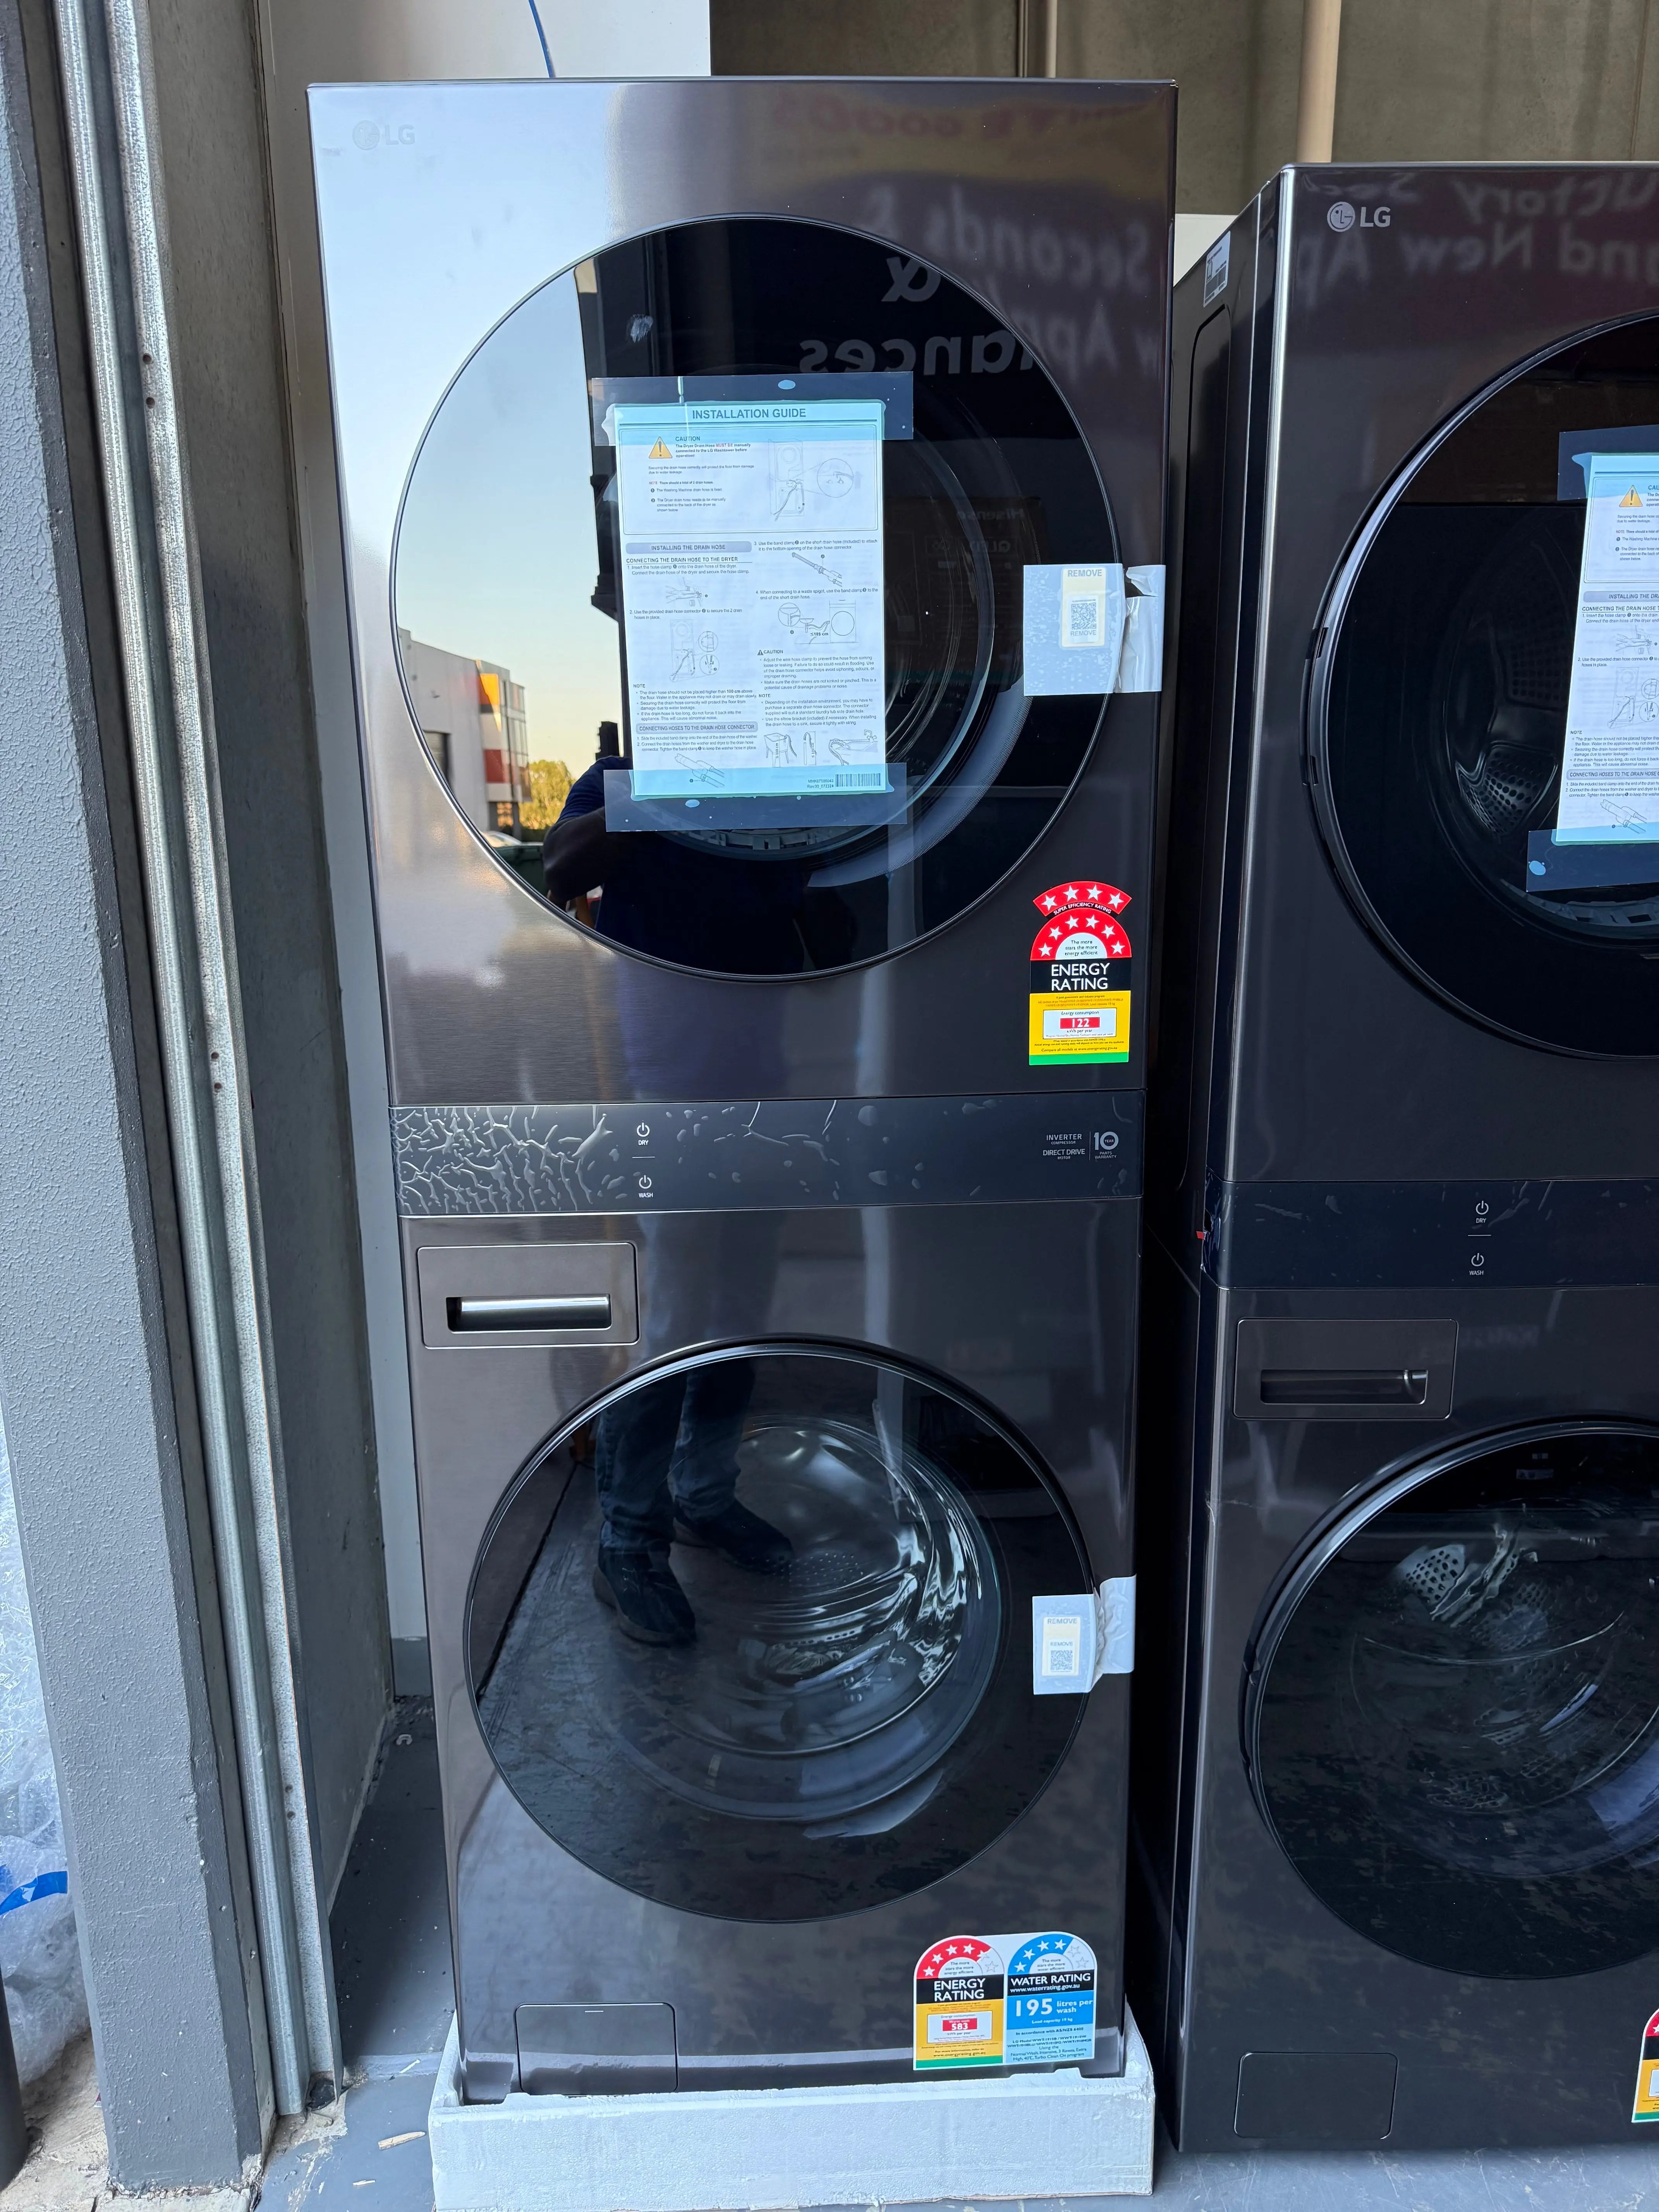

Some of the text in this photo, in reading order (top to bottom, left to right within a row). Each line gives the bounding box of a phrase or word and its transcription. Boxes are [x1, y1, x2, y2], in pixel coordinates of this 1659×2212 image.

[385, 124, 416, 145] LG
[1360, 206, 1391, 227] LG
[692, 408, 806, 419] INSTALLATION GUIDE
[1053, 906, 1067, 915] SUPER
[1094, 903, 1112, 914] RATING
[1051, 963, 1109, 976] ENERGY
[1051, 977, 1108, 991] RATING
[1072, 1018, 1089, 1028] 122
[1094, 1131, 1118, 1150] 10
[934, 1978, 985, 1990] ENERGY
[1011, 1973, 1091, 1986] WATER RATING
[934, 1989, 984, 2001] RATING
[1016, 1997, 1052, 2016] 195
